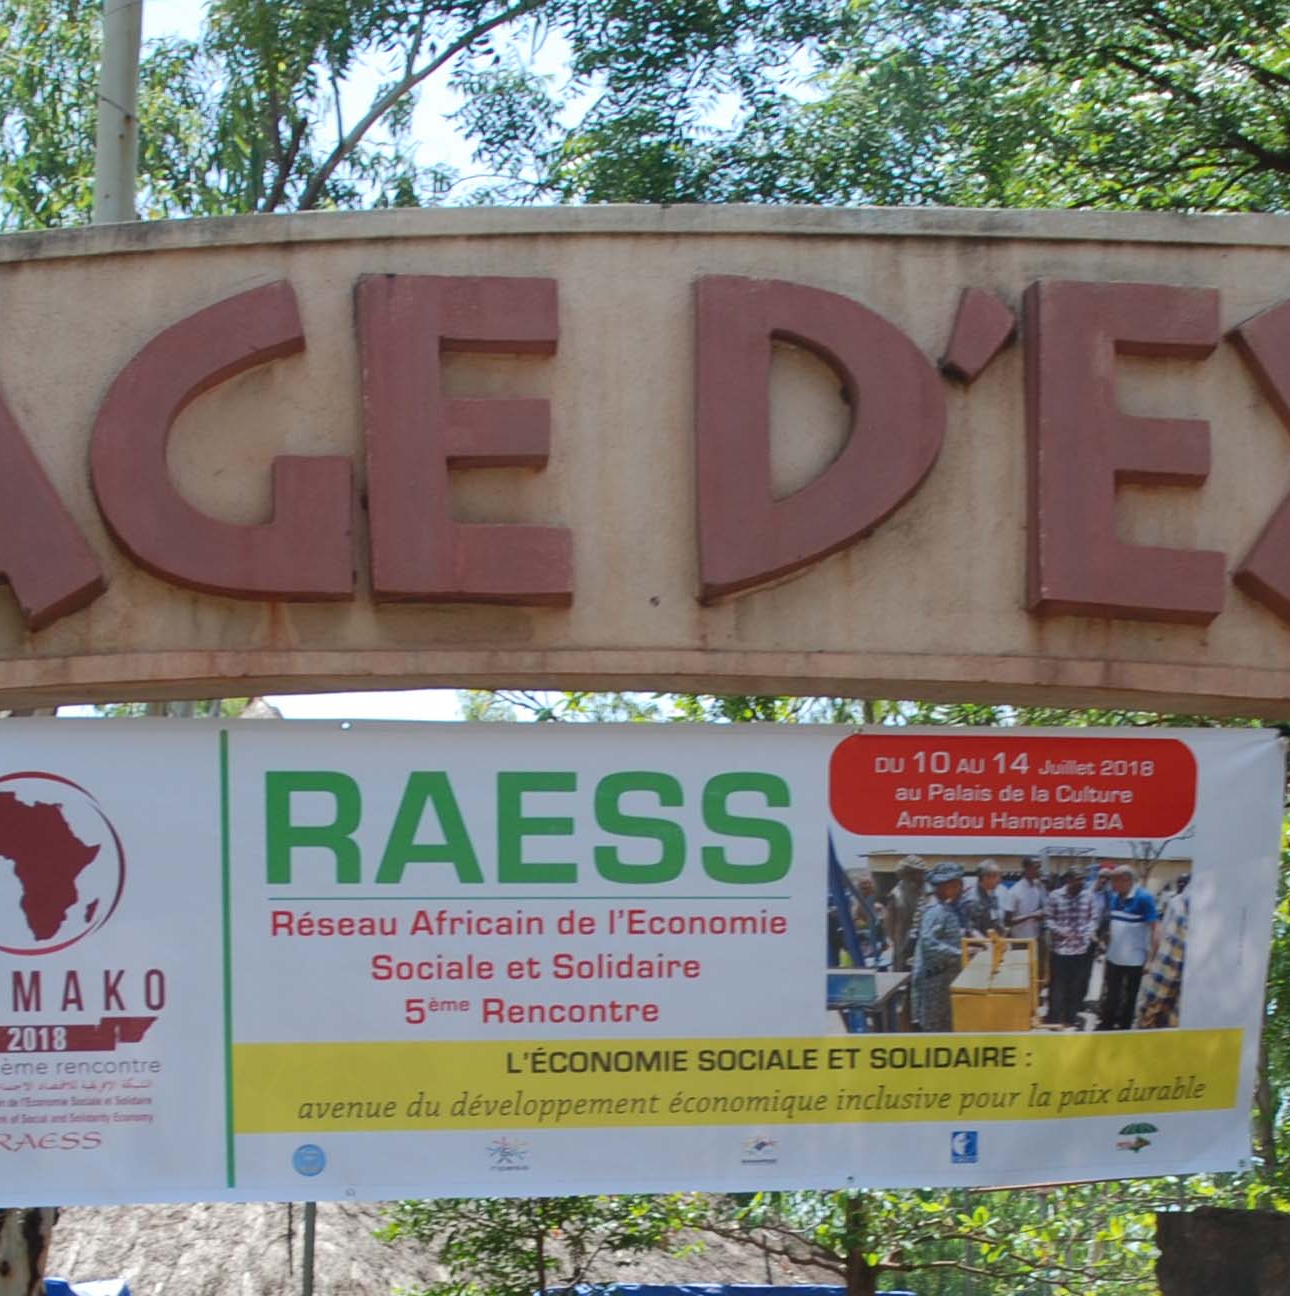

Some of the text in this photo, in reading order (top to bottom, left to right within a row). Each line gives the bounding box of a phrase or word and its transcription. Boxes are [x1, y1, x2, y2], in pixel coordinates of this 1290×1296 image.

[874, 751, 1154, 777] DU 10 AU 14 Juillet 2018
[895, 783, 1133, 804] au Palais de la Culture
[265, 770, 793, 885] RAESS
[896, 811, 1124, 832] Amadou Hampaté BA
[271, 908, 788, 937] Réseau Africain de l'Economie
[371, 953, 701, 981] Sociale et Solidaire
[482, 997, 660, 1024] Rencontre
[7, 1027, 67, 1052] 2018
[56, 1059, 161, 1075] rencontre
[506, 1047, 687, 1074] L'ÉCONOMIE
[697, 1047, 818, 1072] SOCIALE
[828, 1047, 861, 1070] ET
[870, 1046, 1018, 1069] SOLIDAIRE
[298, 1075, 1208, 1123] avenue du développement économique inclusive pour la paix durable
